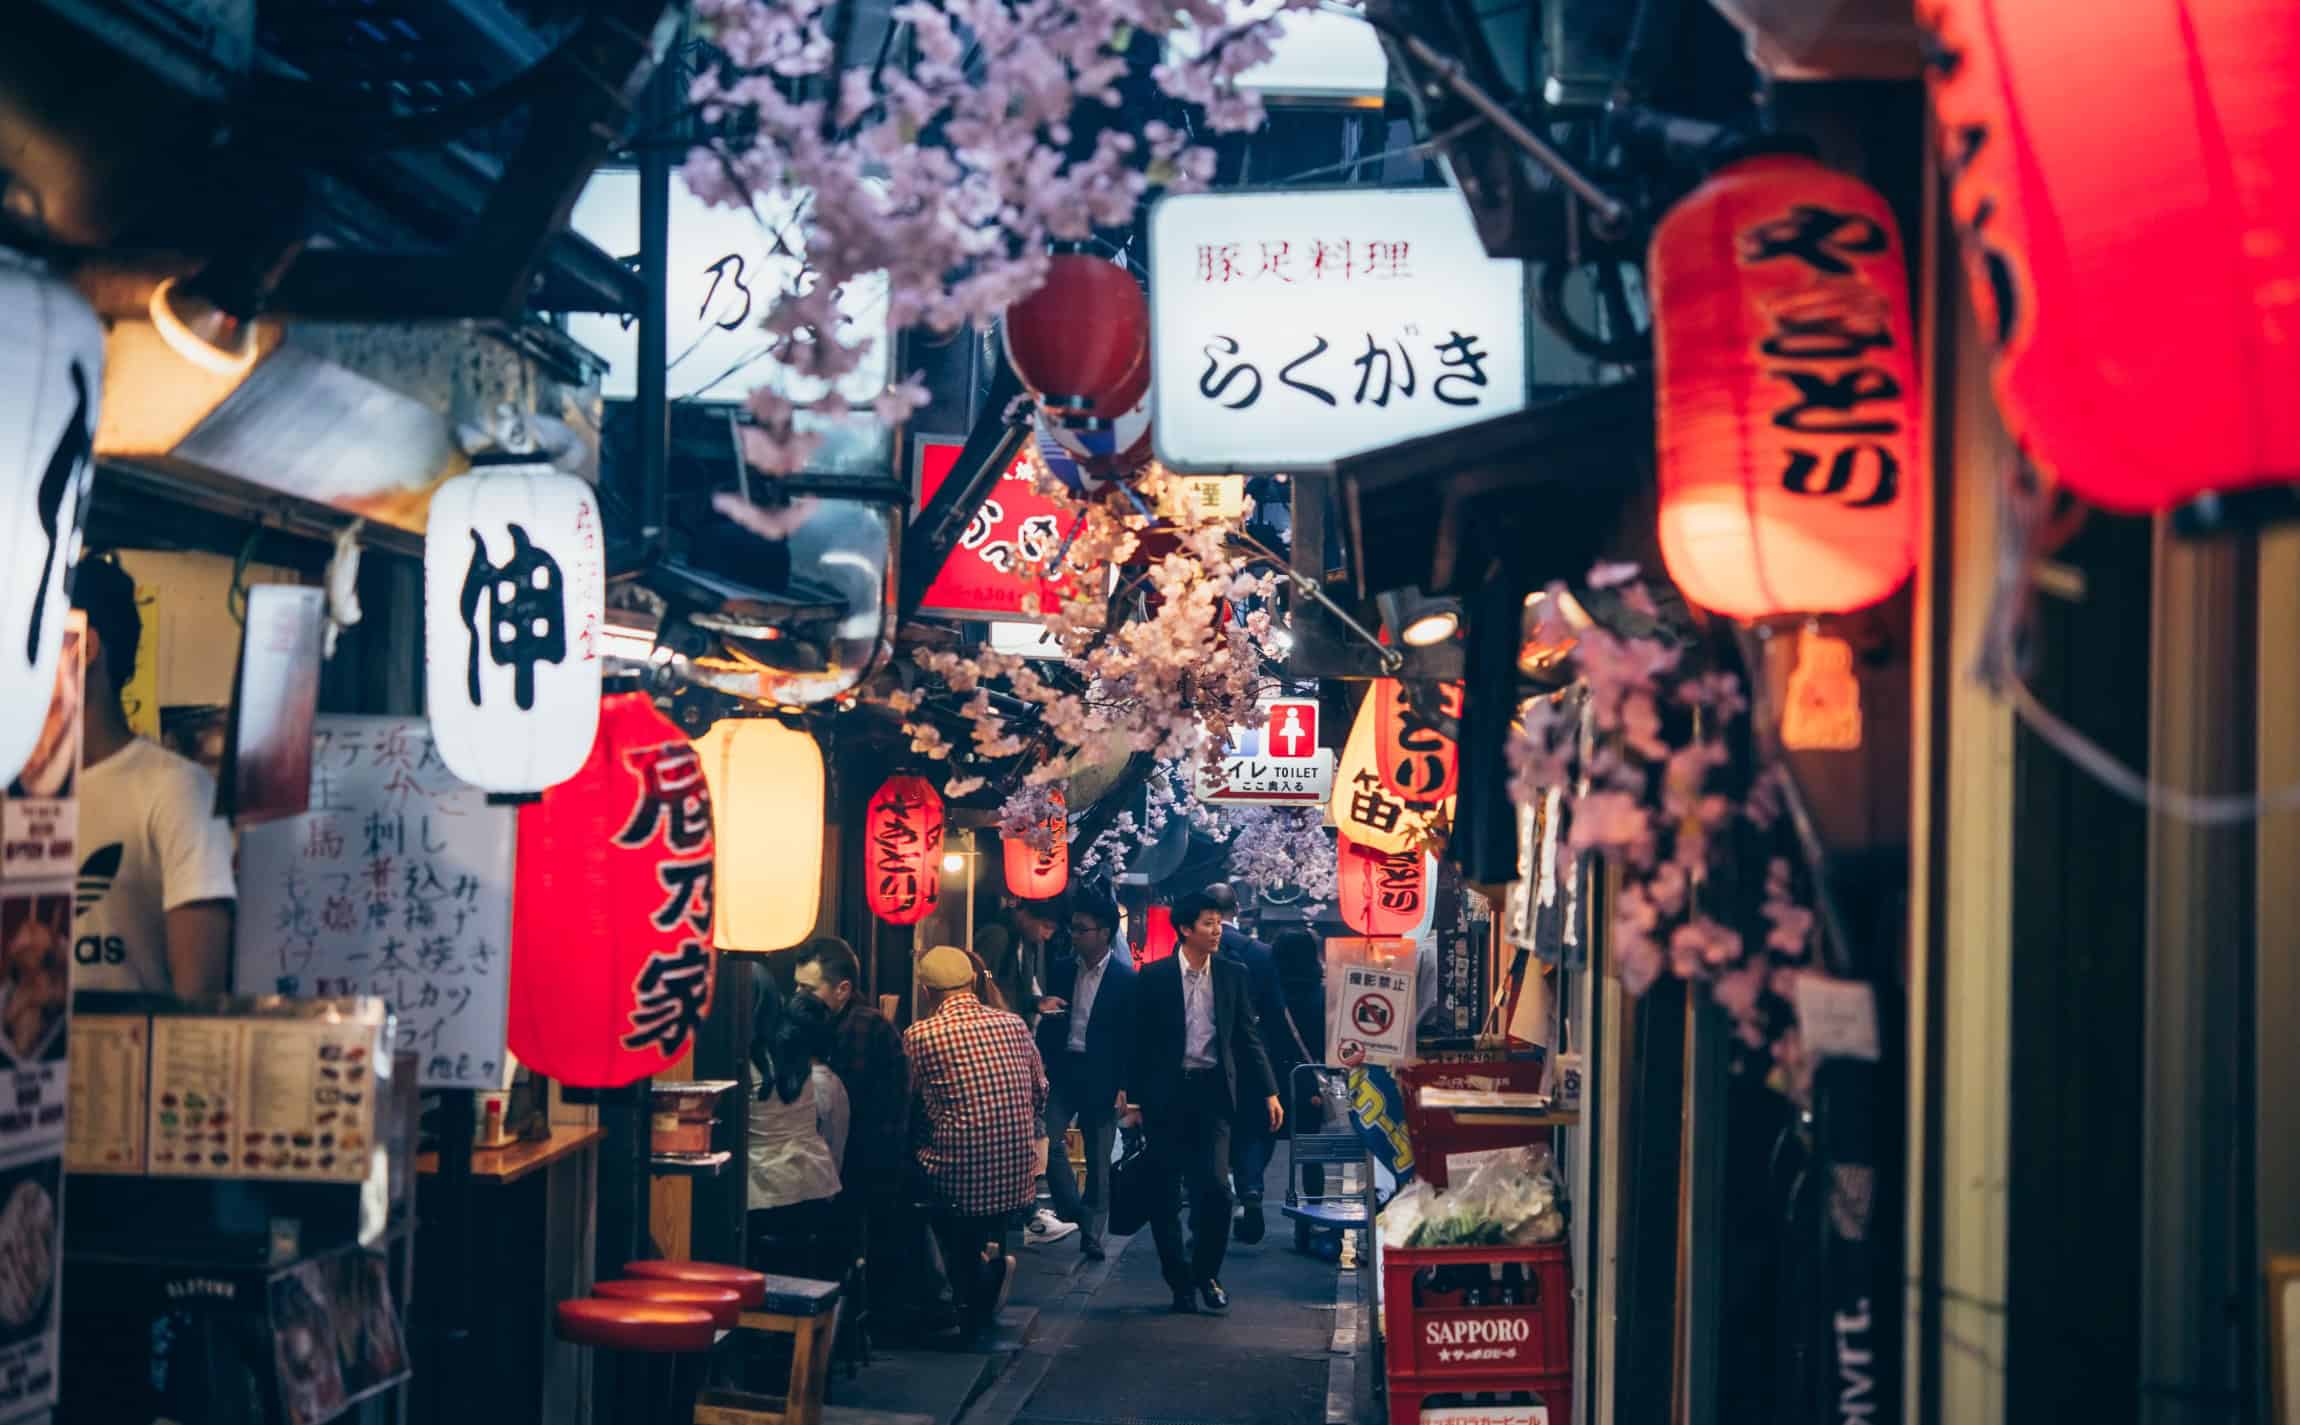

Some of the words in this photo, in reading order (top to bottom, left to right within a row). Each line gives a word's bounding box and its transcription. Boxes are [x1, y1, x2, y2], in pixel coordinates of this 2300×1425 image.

[1195, 239, 1412, 283] 豚足料理
[1198, 325, 1489, 410] らくがき
[1274, 767, 1319, 779] TOILET
[1426, 1318, 1530, 1345] SAPPORO
